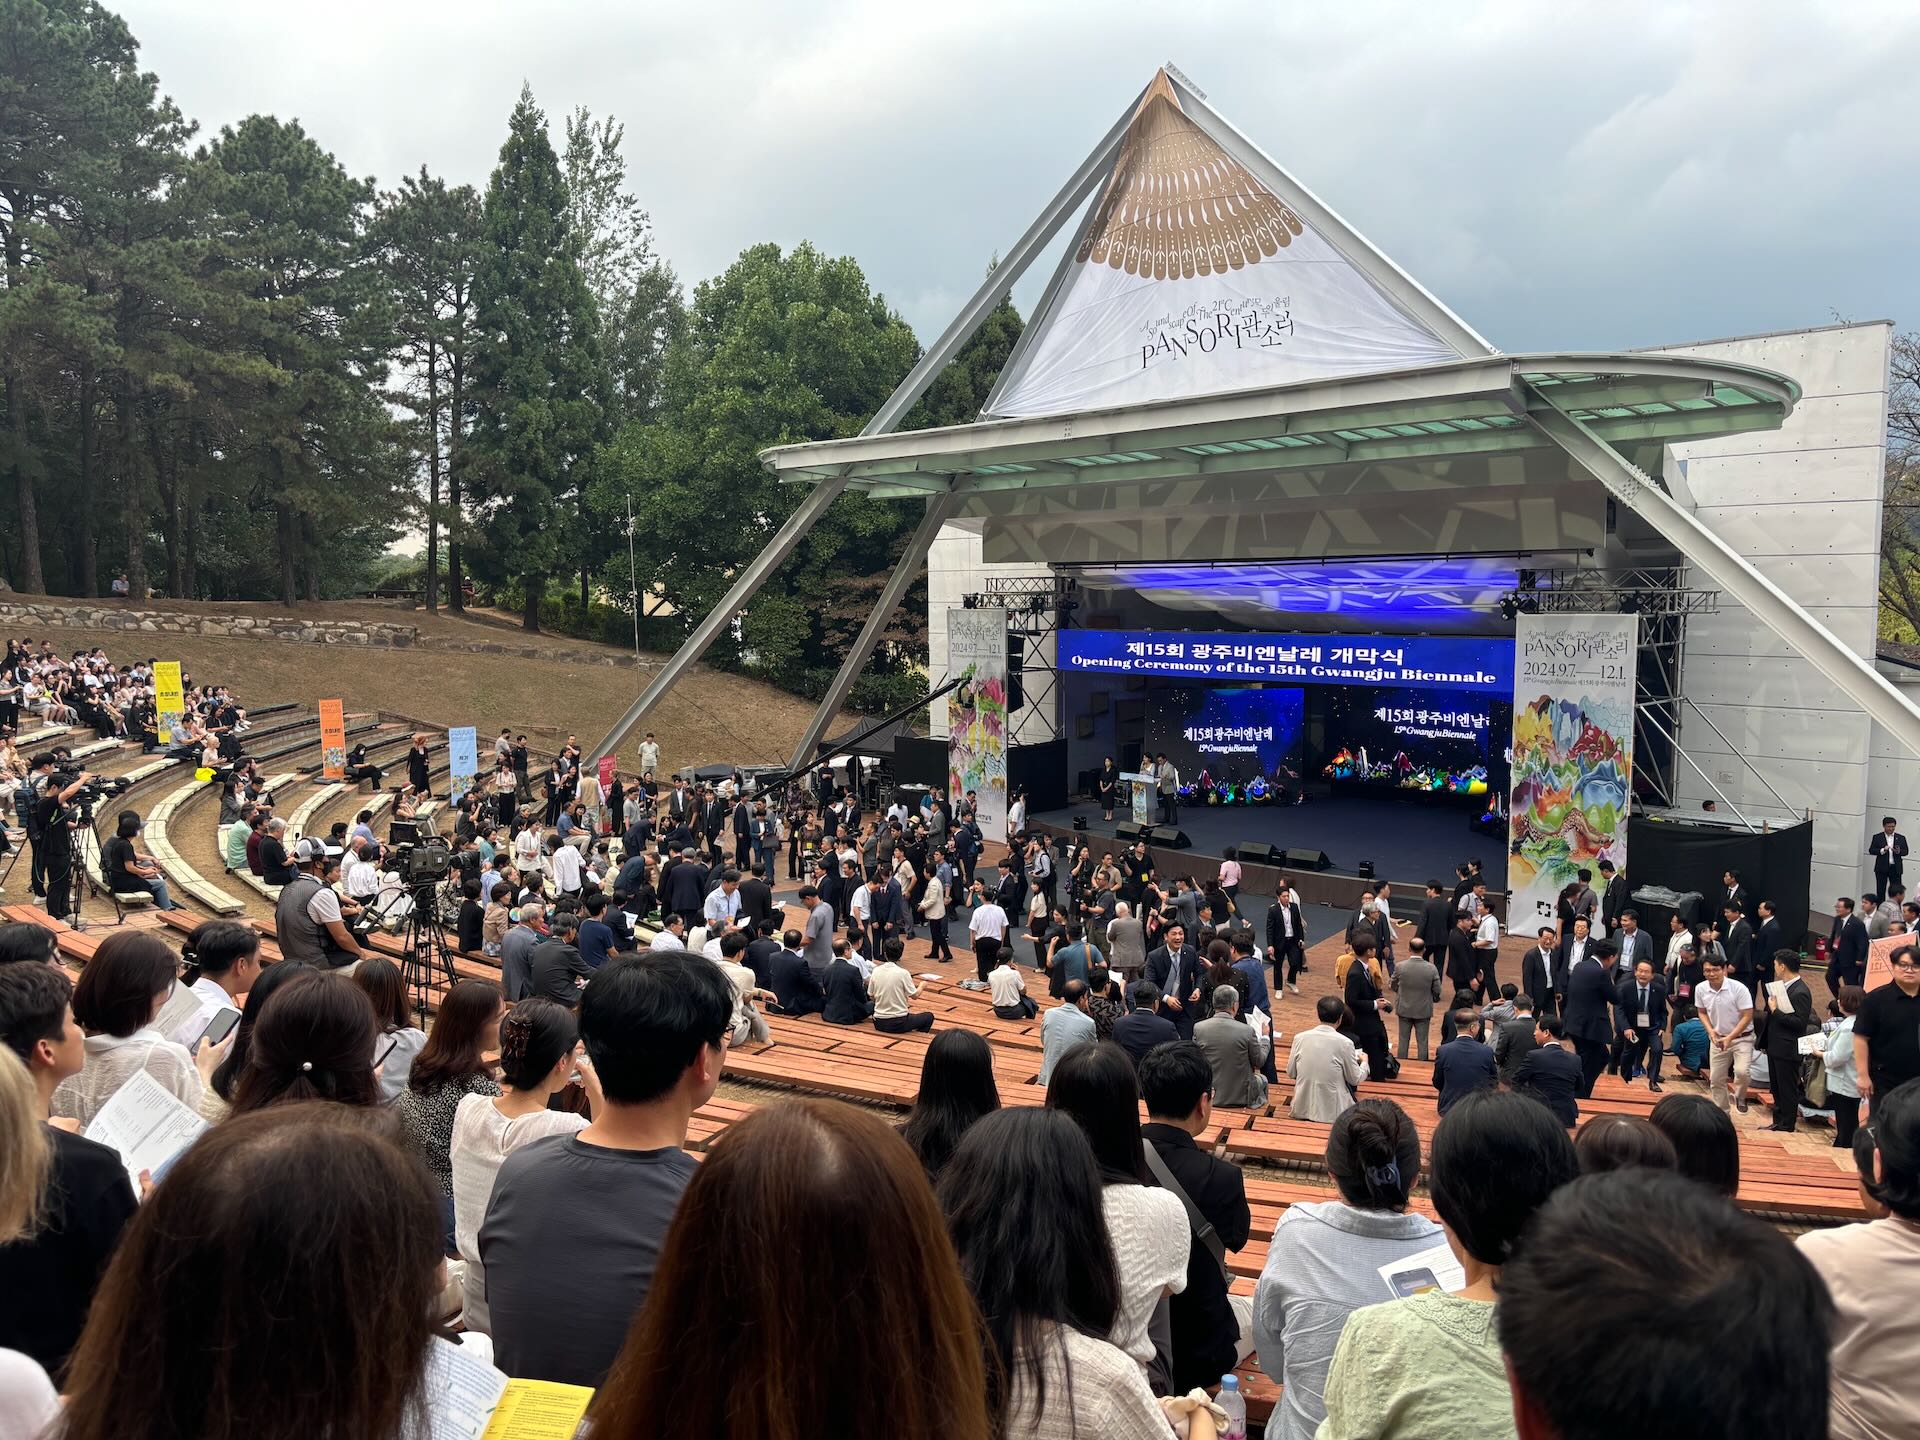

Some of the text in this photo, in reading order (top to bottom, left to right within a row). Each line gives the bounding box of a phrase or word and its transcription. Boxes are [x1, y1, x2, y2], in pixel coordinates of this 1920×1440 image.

[1241, 310, 1294, 348] 판소리
[1141, 313, 1243, 369] PANSORI
[1126, 641, 1404, 666] 제15회 광주비엔날레 개막식
[1525, 637, 1595, 659] PANSORI
[1593, 638, 1628, 660] 판소리
[1071, 655, 1496, 684] Opening Ceremony of the 15th Gwangju Biennale
[1374, 706, 1414, 723] 제15회
[1183, 726, 1273, 741] 제15회 광주비엔날레
[1406, 726, 1443, 738] Gwangju
[1442, 729, 1477, 740] Biennale
